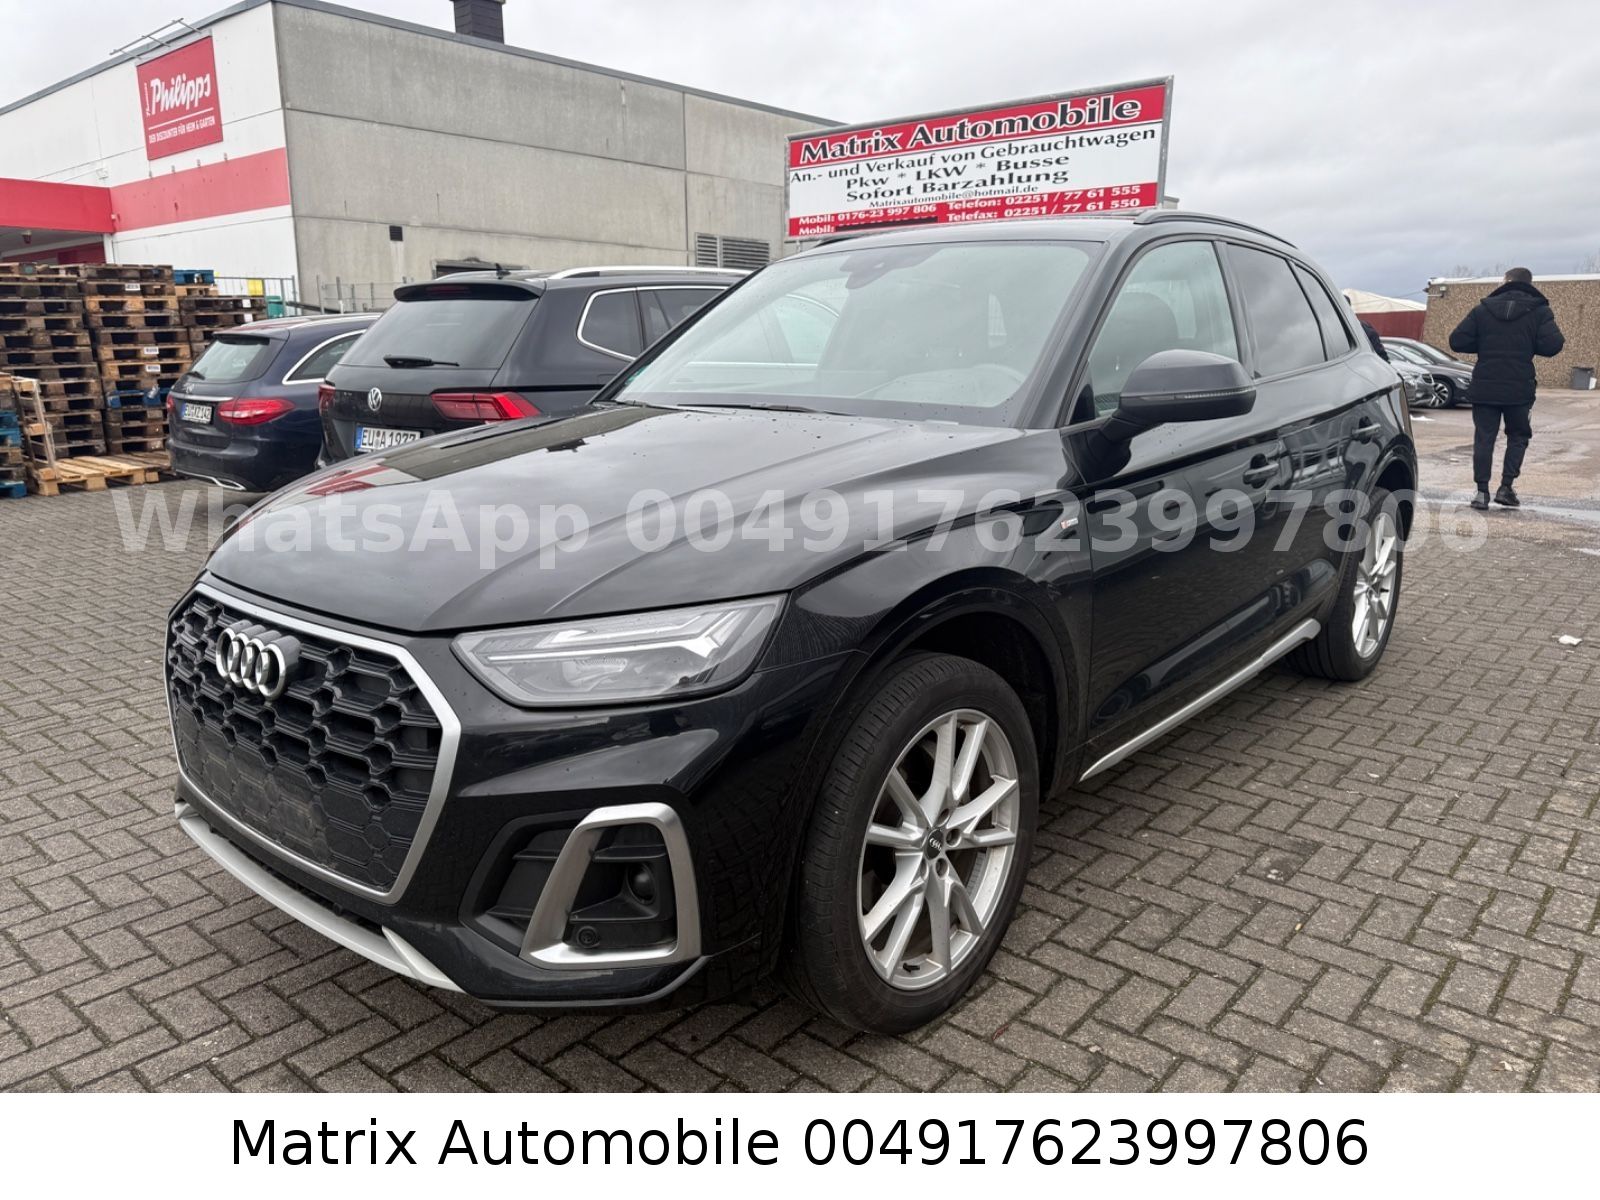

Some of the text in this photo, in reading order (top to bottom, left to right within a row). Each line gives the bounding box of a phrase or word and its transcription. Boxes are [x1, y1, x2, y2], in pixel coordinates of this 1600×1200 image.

[150, 73, 211, 115] Philipps
[800, 95, 1141, 164] Matrix Automobile
[828, 163, 860, 178] und
[866, 153, 935, 172] Verkauf
[941, 151, 975, 163] von
[981, 129, 1156, 159] Gebrauchtwagen
[846, 155, 1070, 189] Pkw LKW Busse
[846, 170, 1070, 202] Sofort Barzahlung
[868, 185, 1039, 208] Matrixautomobile@hotmail.de
[947, 198, 1002, 210] Telefon:
[1005, 193, 1049, 206] 02251
[1063, 190, 1083, 201] 77
[1086, 188, 1105, 198] 61
[1111, 184, 1141, 197] 555
[798, 216, 836, 226] Mobil:
[837, 209, 884, 222] 0176-23
[887, 205, 911, 216] 997
[913, 203, 937, 214] 806
[946, 211, 998, 223] Telefax:
[1004, 205, 1047, 218] 02251
[1062, 203, 1082, 213] 77
[1086, 200, 1105, 211] 61
[1110, 198, 1140, 209] 550
[798, 226, 836, 236] Mobil:
[361, 429, 375, 447] EU
[379, 430, 386, 447] A
